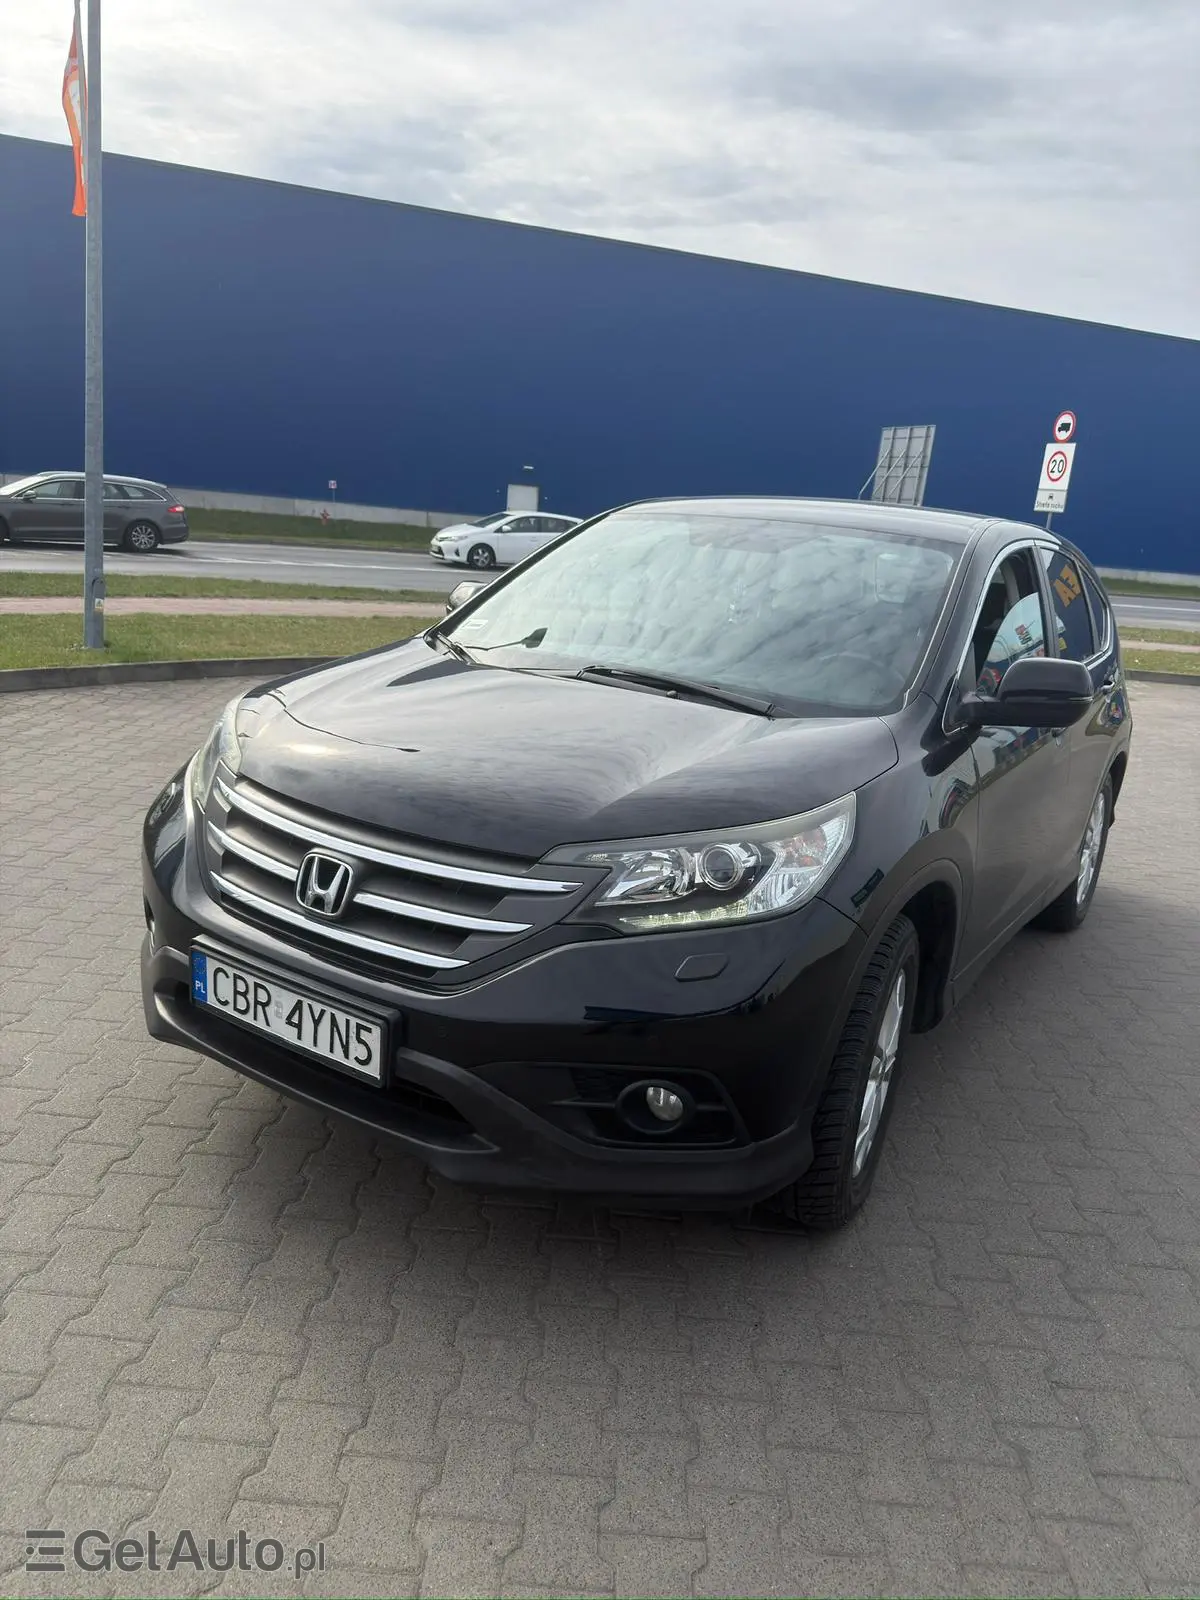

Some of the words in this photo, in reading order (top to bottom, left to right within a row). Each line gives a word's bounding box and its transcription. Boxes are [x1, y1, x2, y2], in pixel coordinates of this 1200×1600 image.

[1050, 459, 1065, 474] 20
[195, 980, 206, 994] PL
[213, 966, 272, 1028] CBR
[284, 999, 373, 1066] 4YN5
